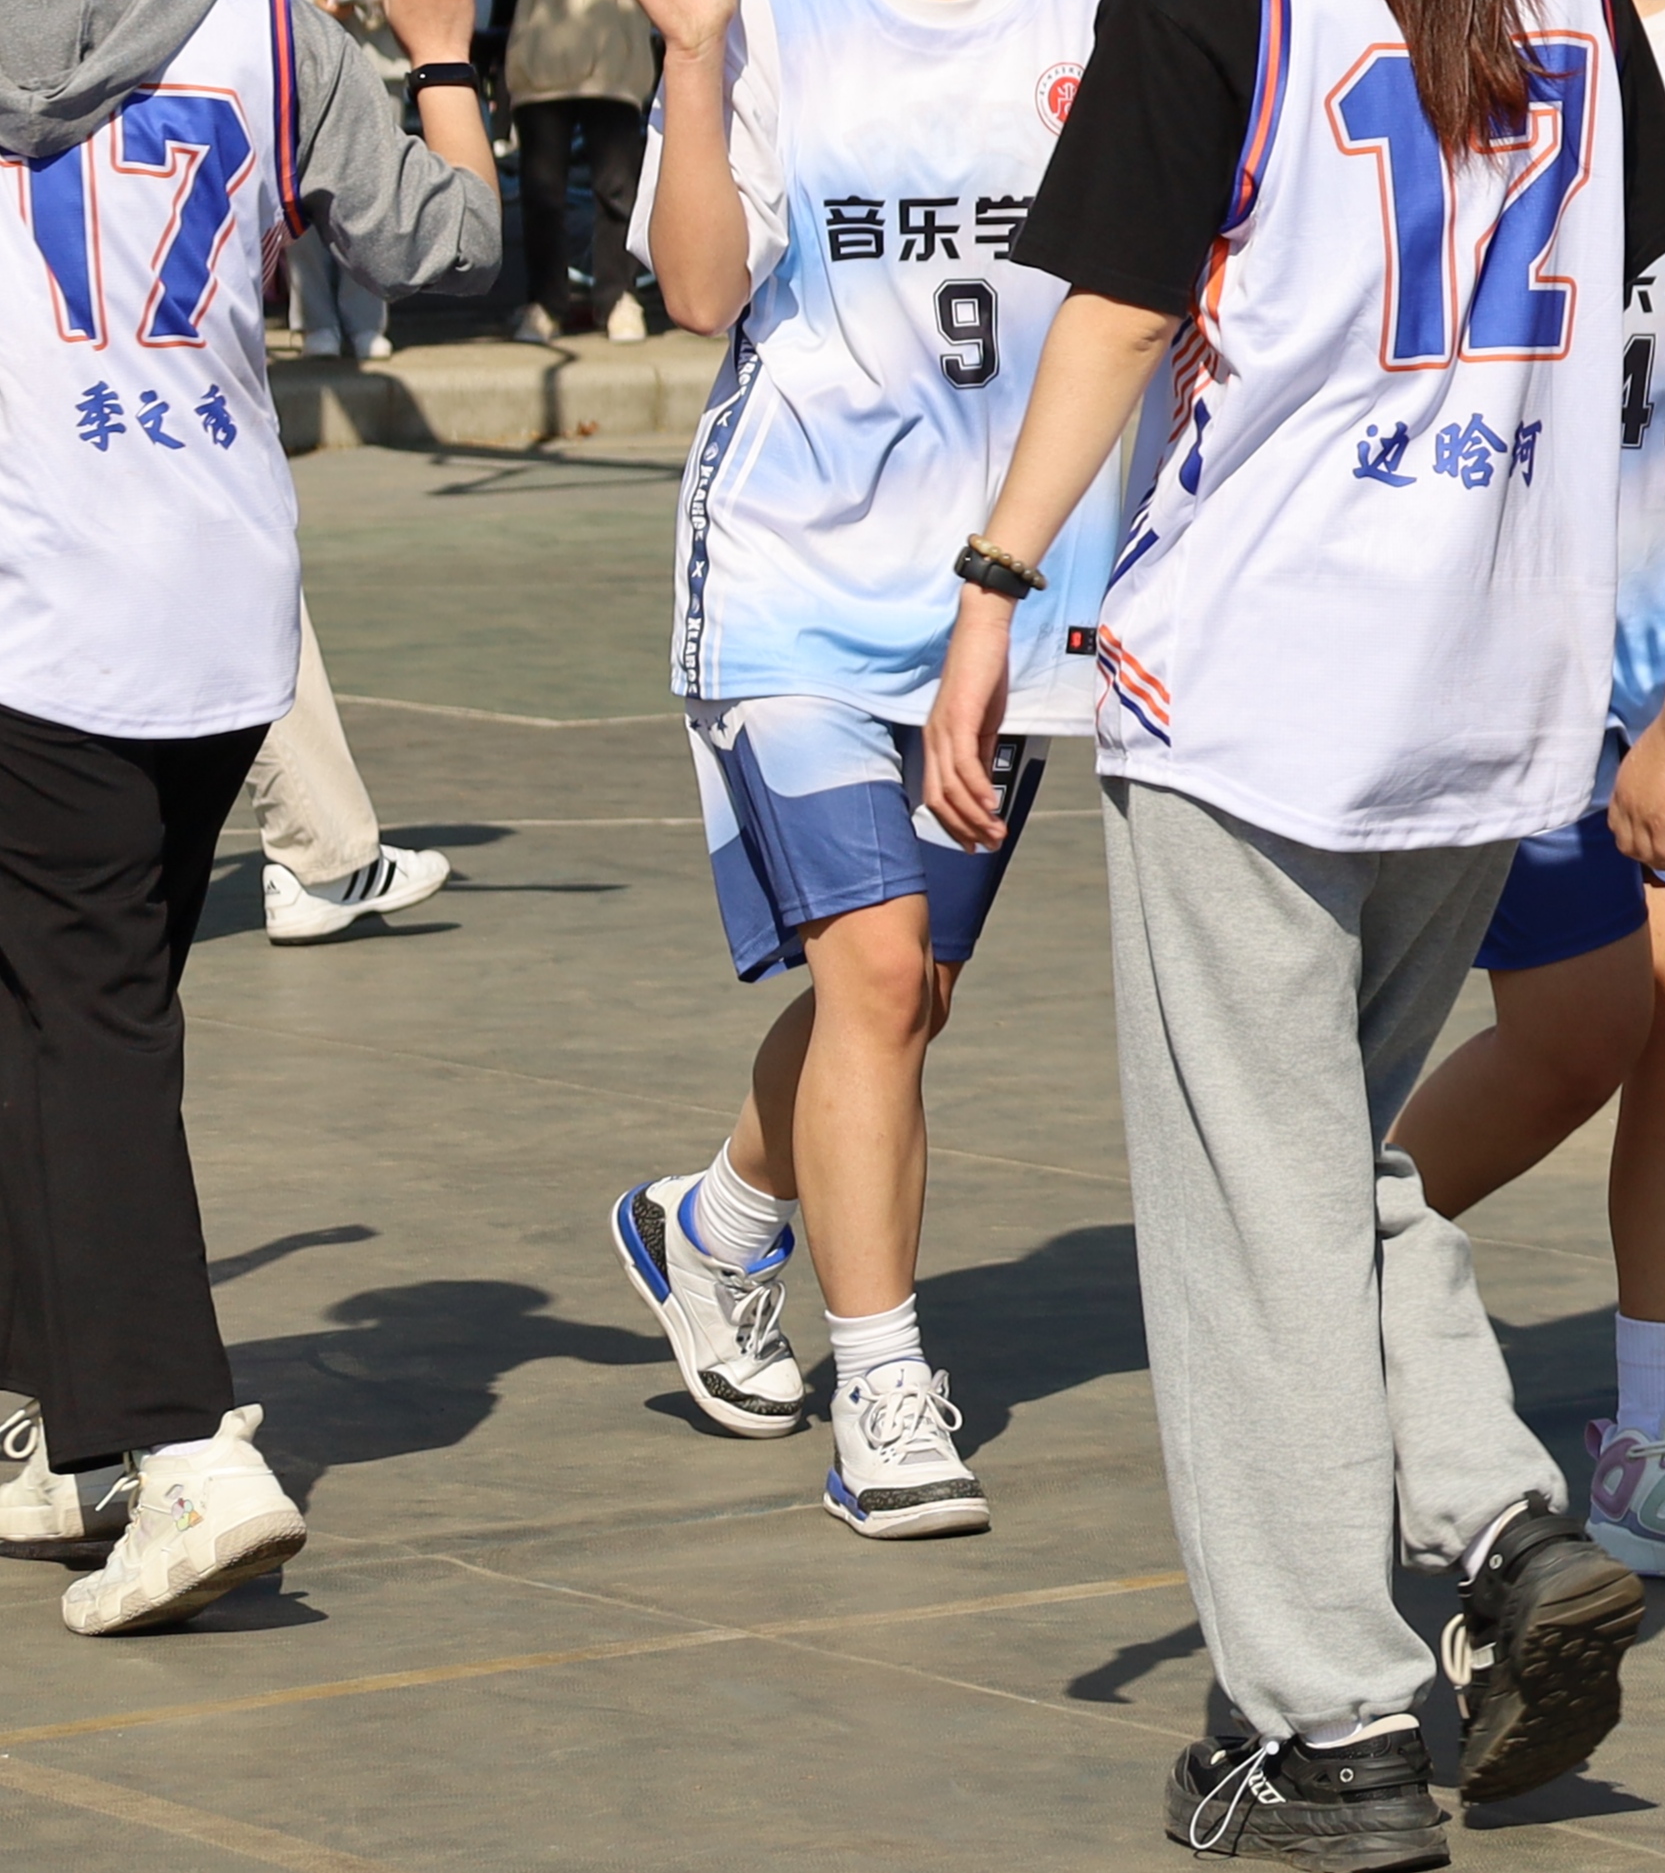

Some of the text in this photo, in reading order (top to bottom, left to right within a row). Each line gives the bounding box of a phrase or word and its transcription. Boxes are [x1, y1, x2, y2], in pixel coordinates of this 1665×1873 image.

[0, 83, 256, 351] 17
[933, 278, 999, 389] 9
[1325, 29, 1597, 372] 12
